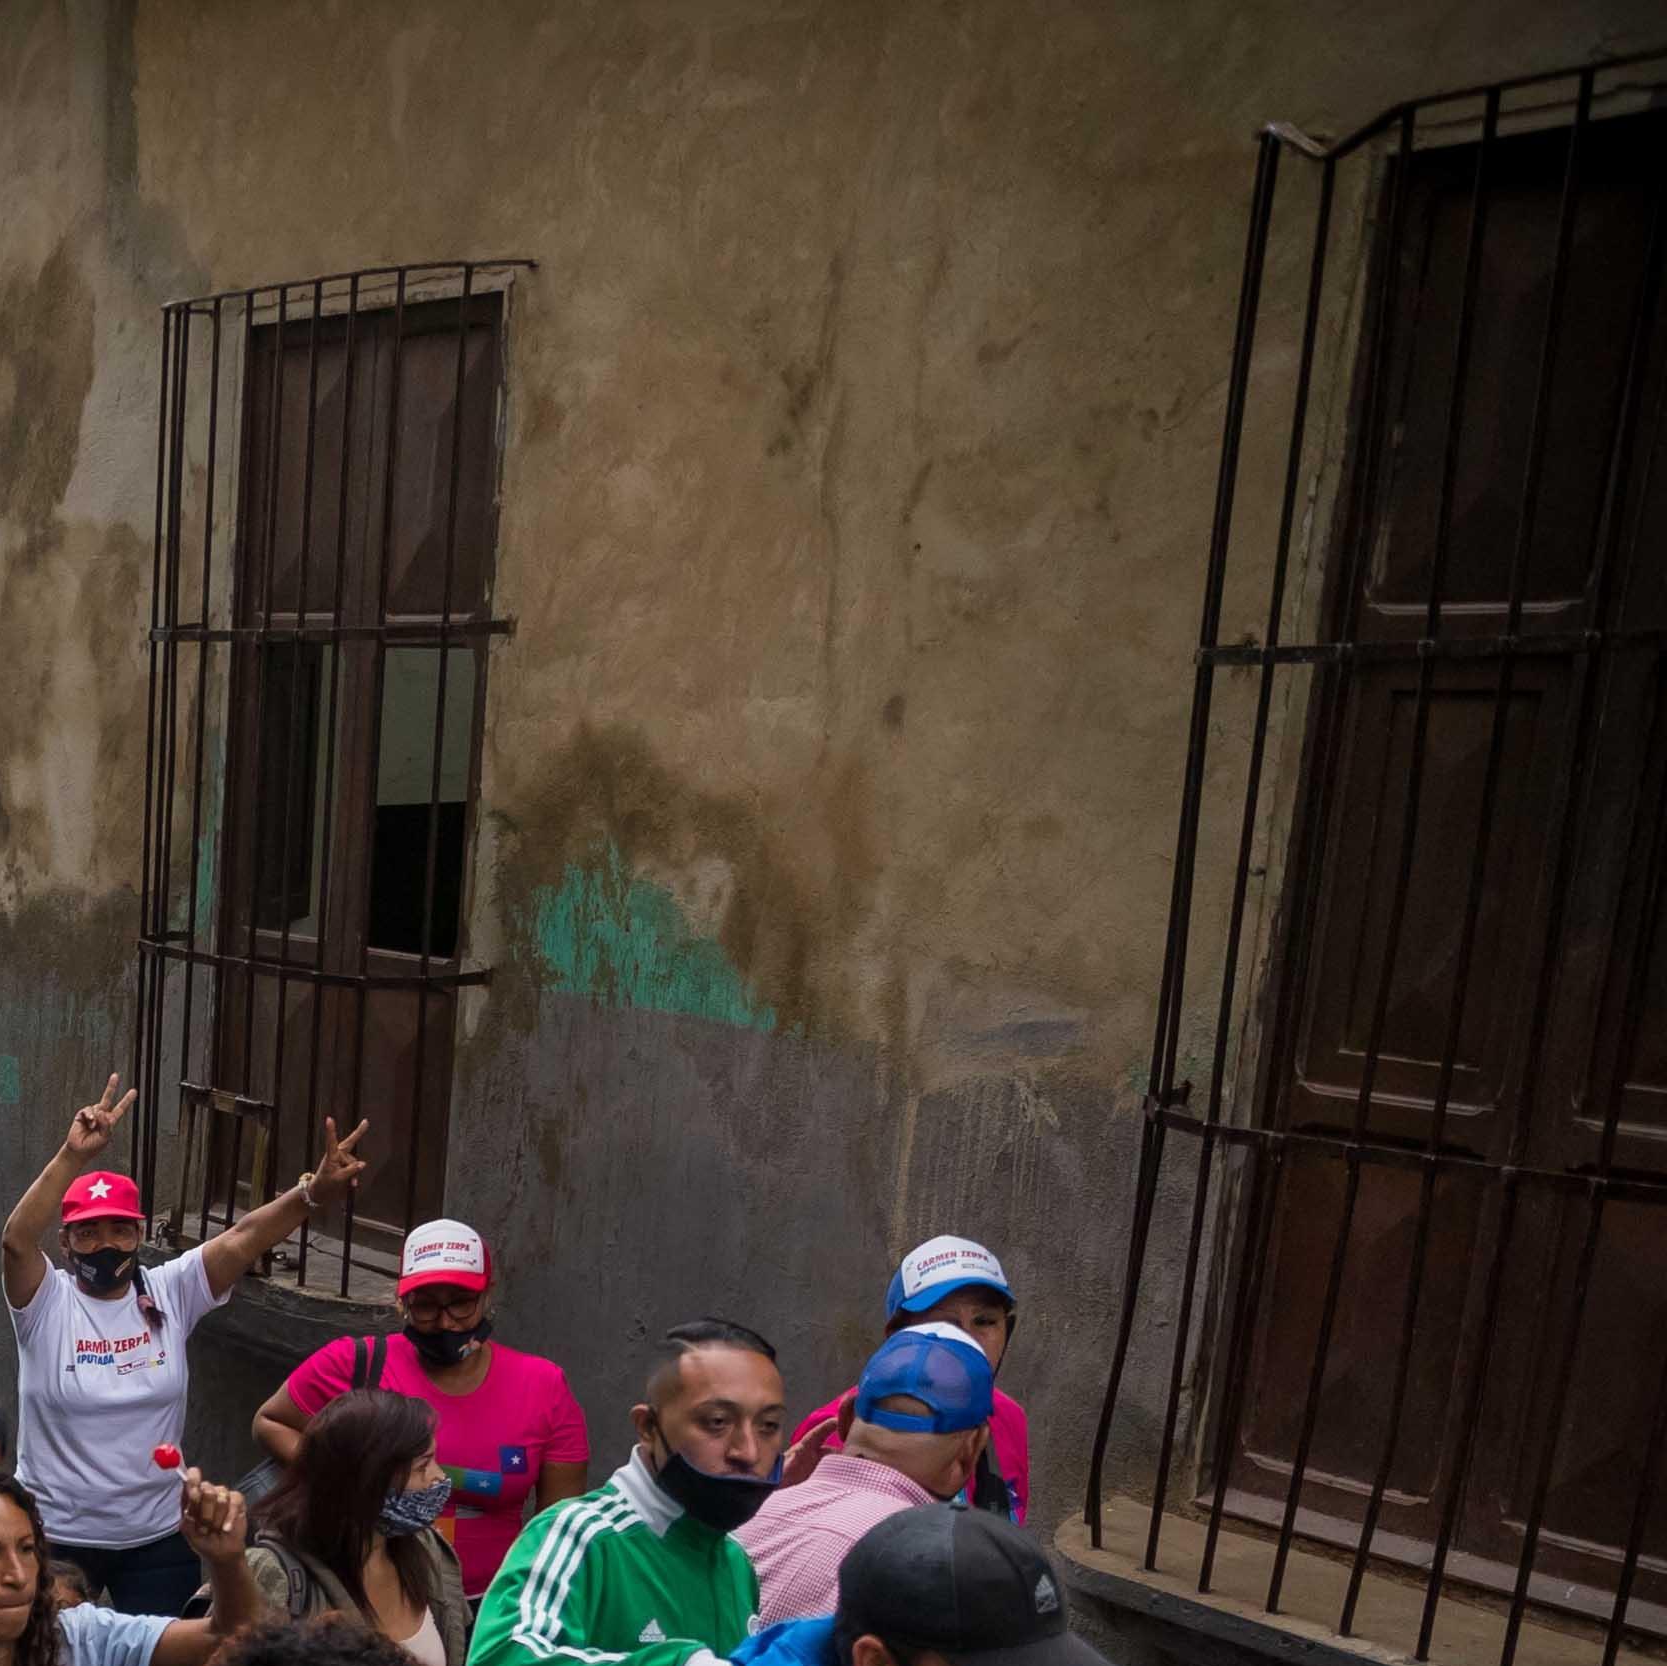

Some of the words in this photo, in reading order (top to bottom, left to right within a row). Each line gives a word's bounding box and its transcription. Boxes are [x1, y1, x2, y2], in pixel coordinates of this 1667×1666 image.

[414, 1242, 444, 1257] CARMEN
[446, 1241, 470, 1252] ZERPA
[916, 1250, 958, 1271] CARMEN
[960, 1251, 989, 1262] ZERPA
